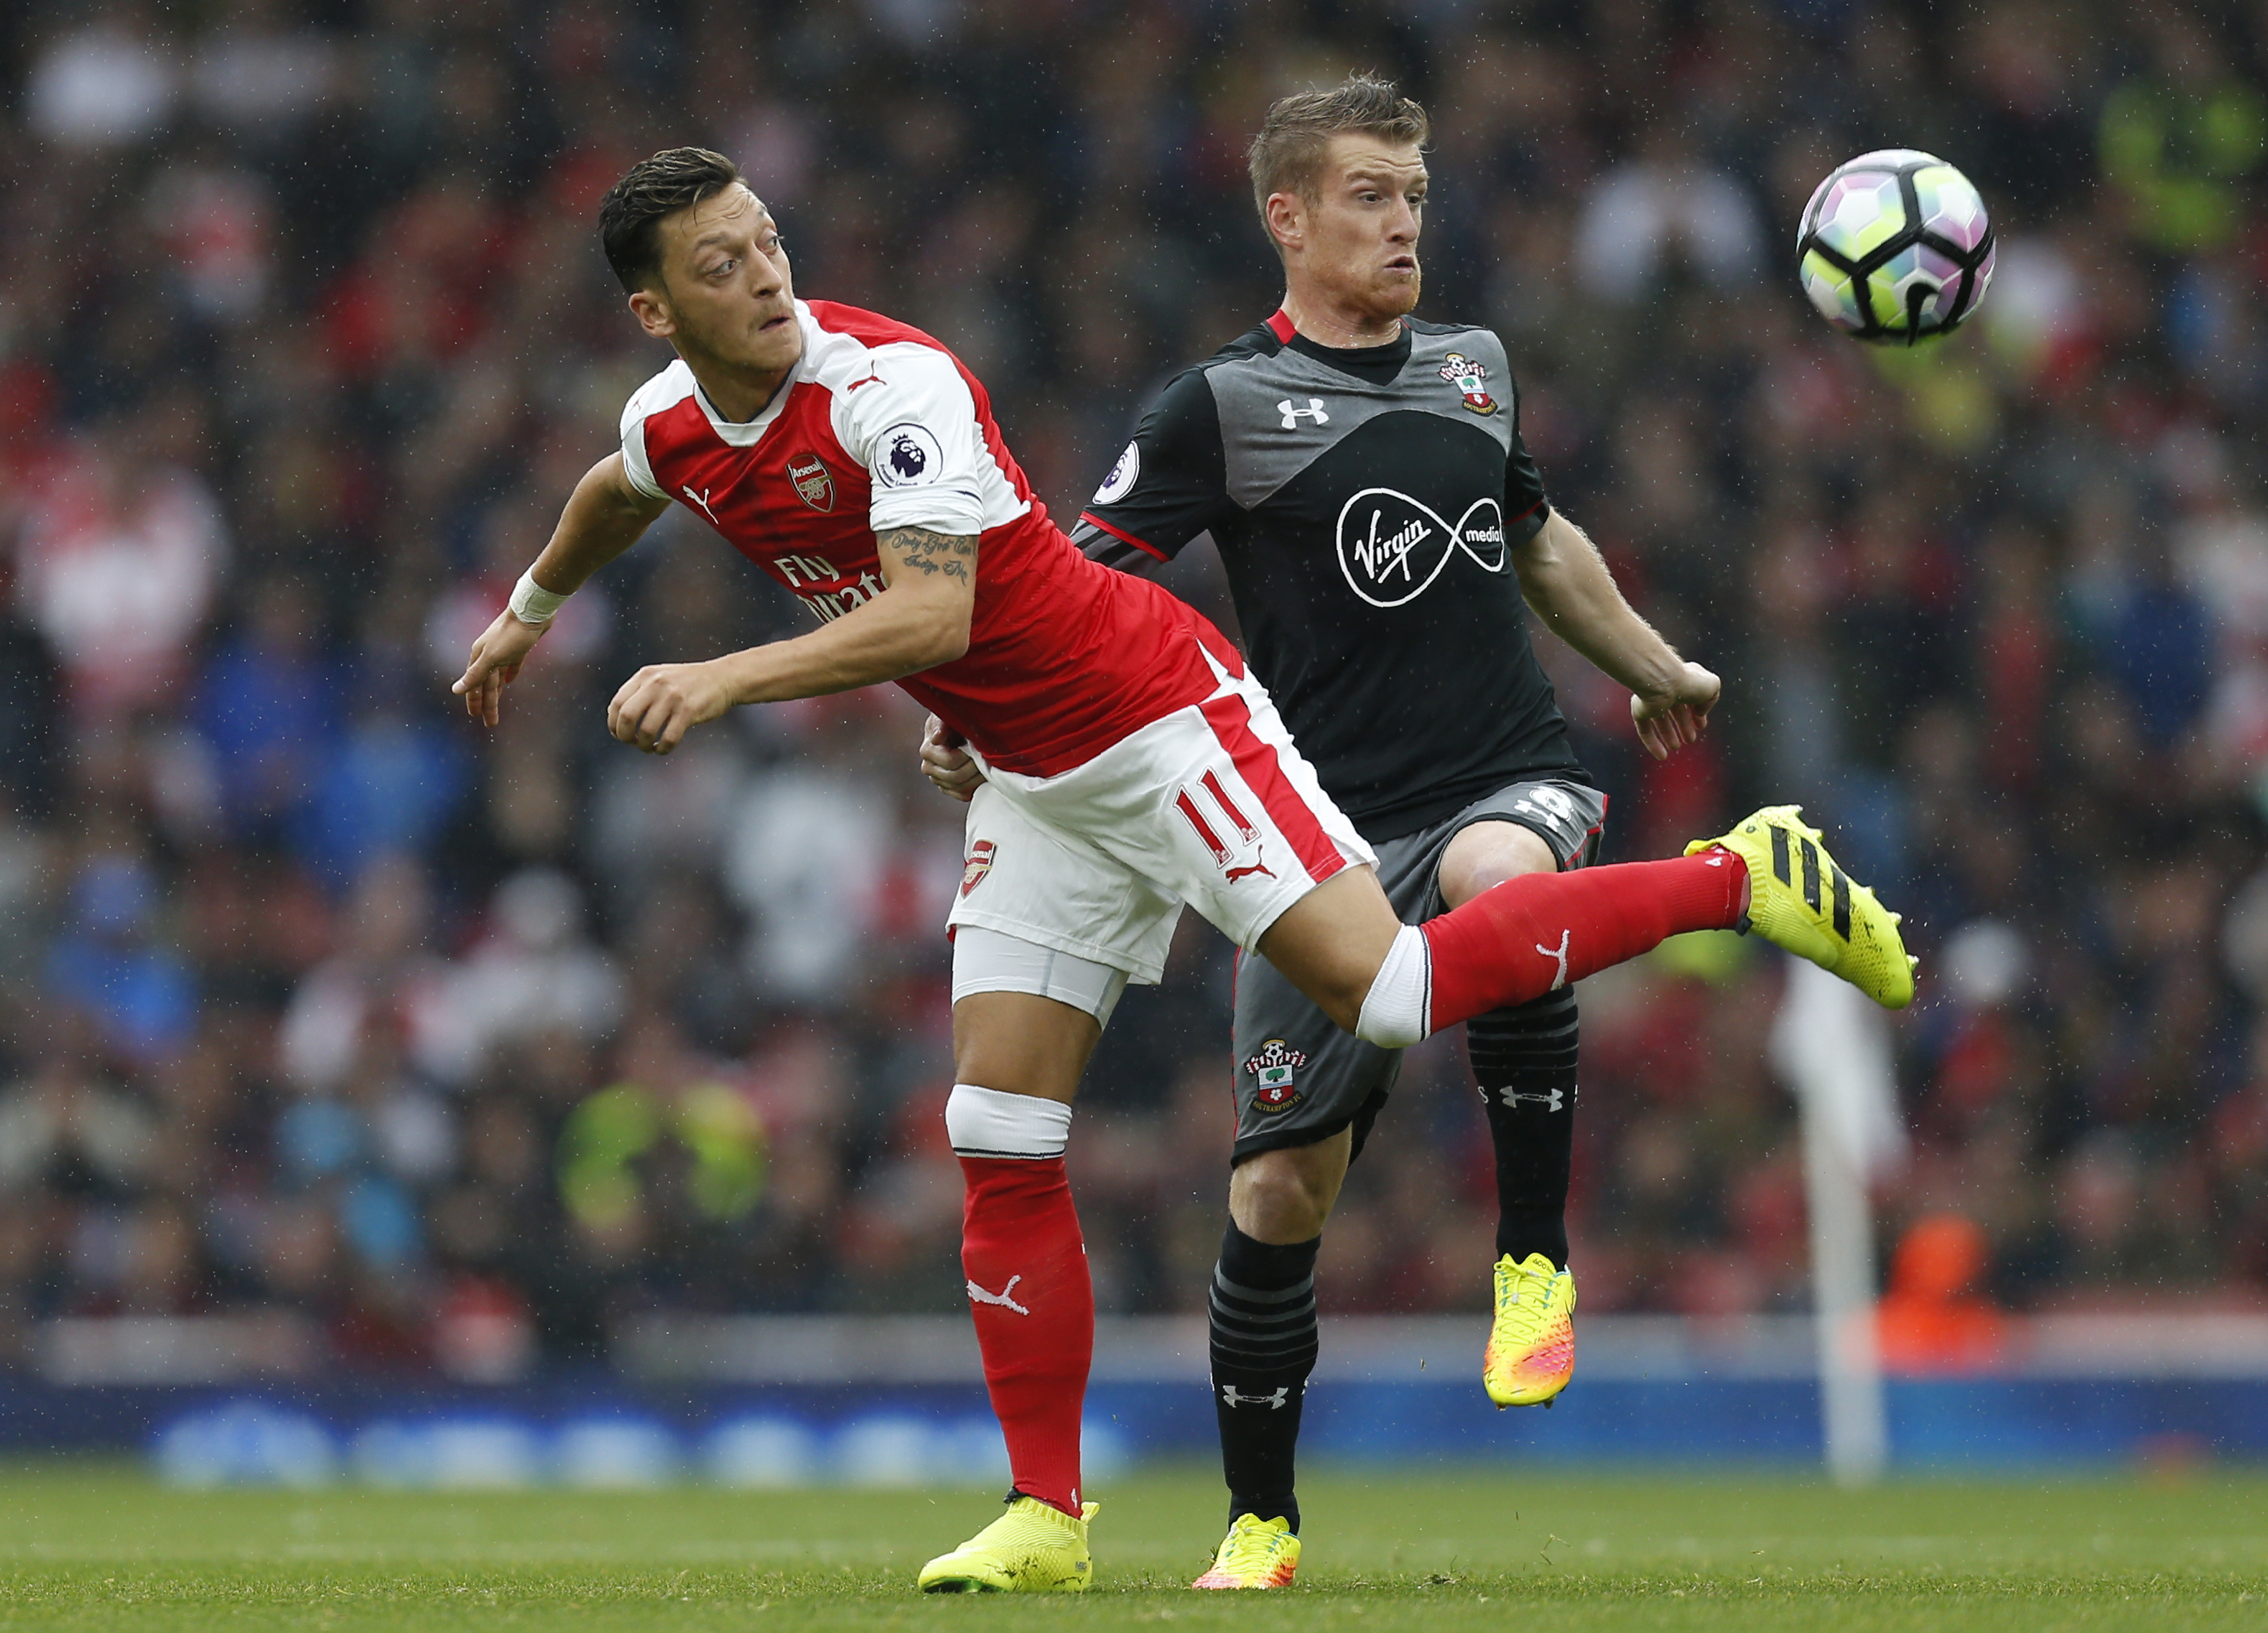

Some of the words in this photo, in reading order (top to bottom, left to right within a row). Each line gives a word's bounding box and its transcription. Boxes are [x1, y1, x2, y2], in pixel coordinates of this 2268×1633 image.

[791, 460, 823, 479] Arsenal
[1354, 509, 1432, 584] Virgin
[1466, 526, 1500, 543] media
[773, 555, 840, 587] Fly
[1172, 765, 1262, 870] 11
[970, 850, 992, 860] rsenal
